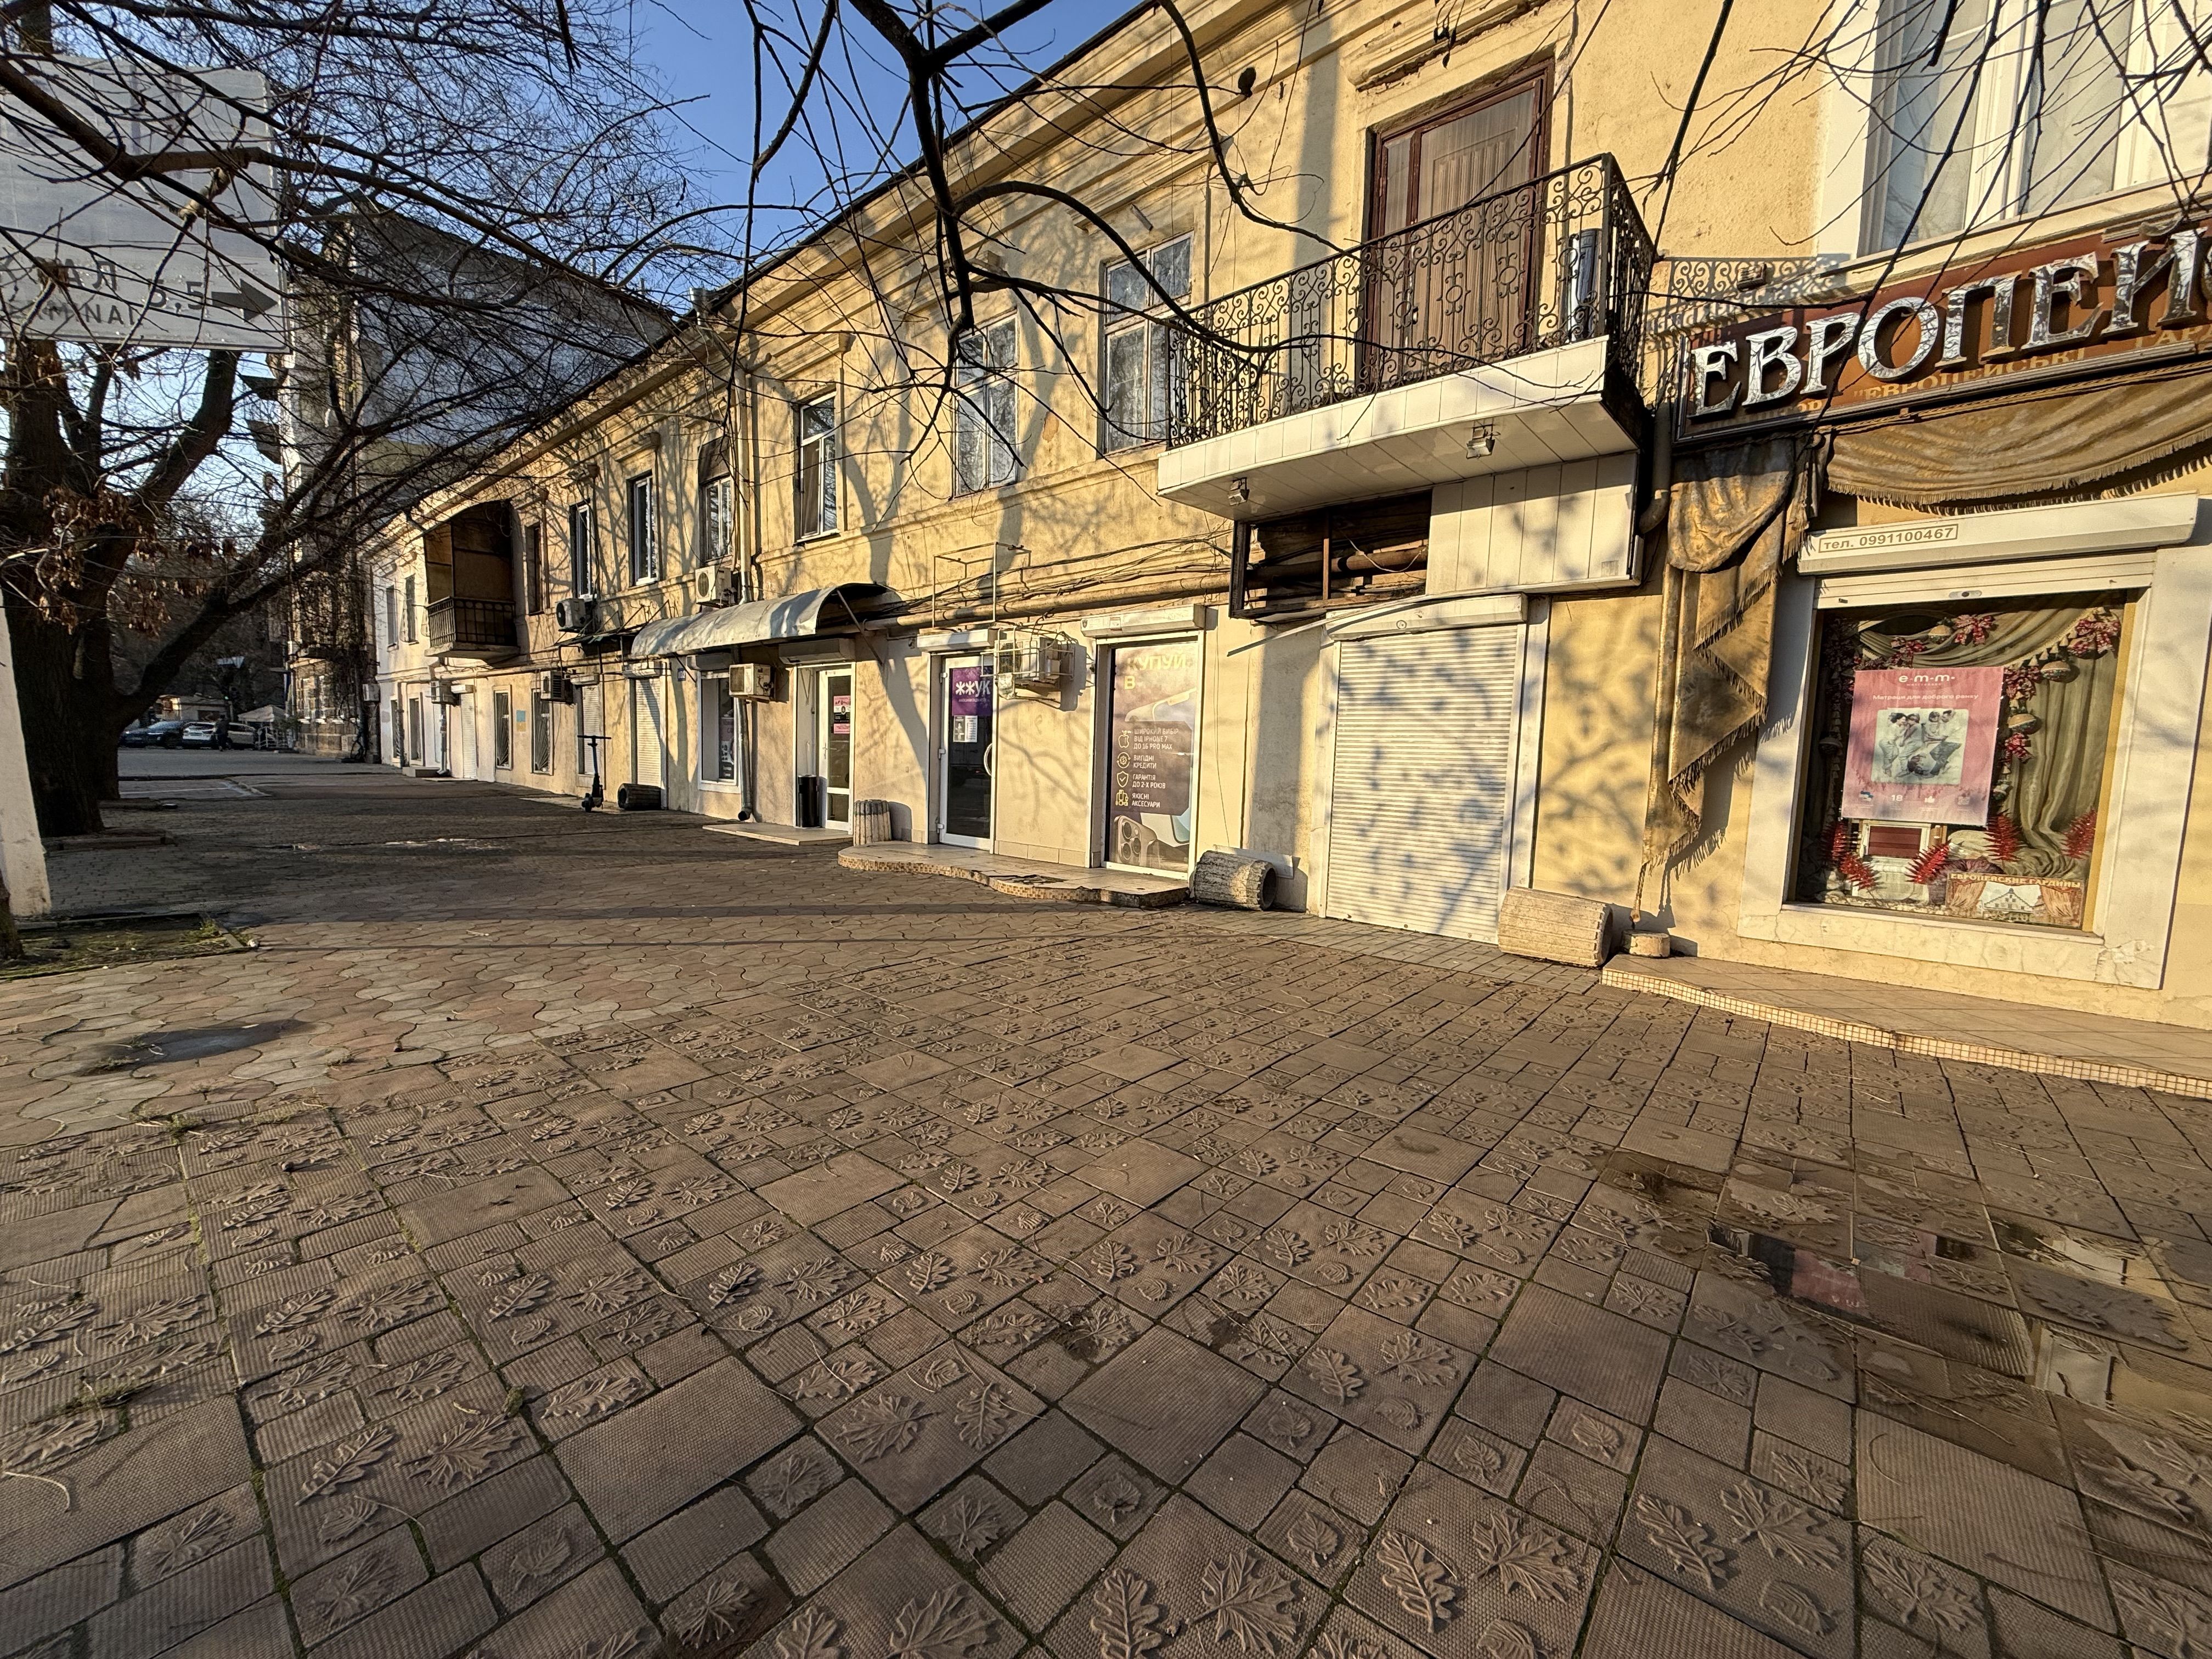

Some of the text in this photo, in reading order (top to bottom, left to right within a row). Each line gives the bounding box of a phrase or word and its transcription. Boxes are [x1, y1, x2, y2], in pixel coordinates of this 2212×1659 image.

[1824, 527, 1954, 549] тел. 0991100467
[1127, 651, 1186, 672] КУПУЙ
[1124, 675, 1136, 690] В
[2029, 878, 2081, 888] ГАРДИНЫ
